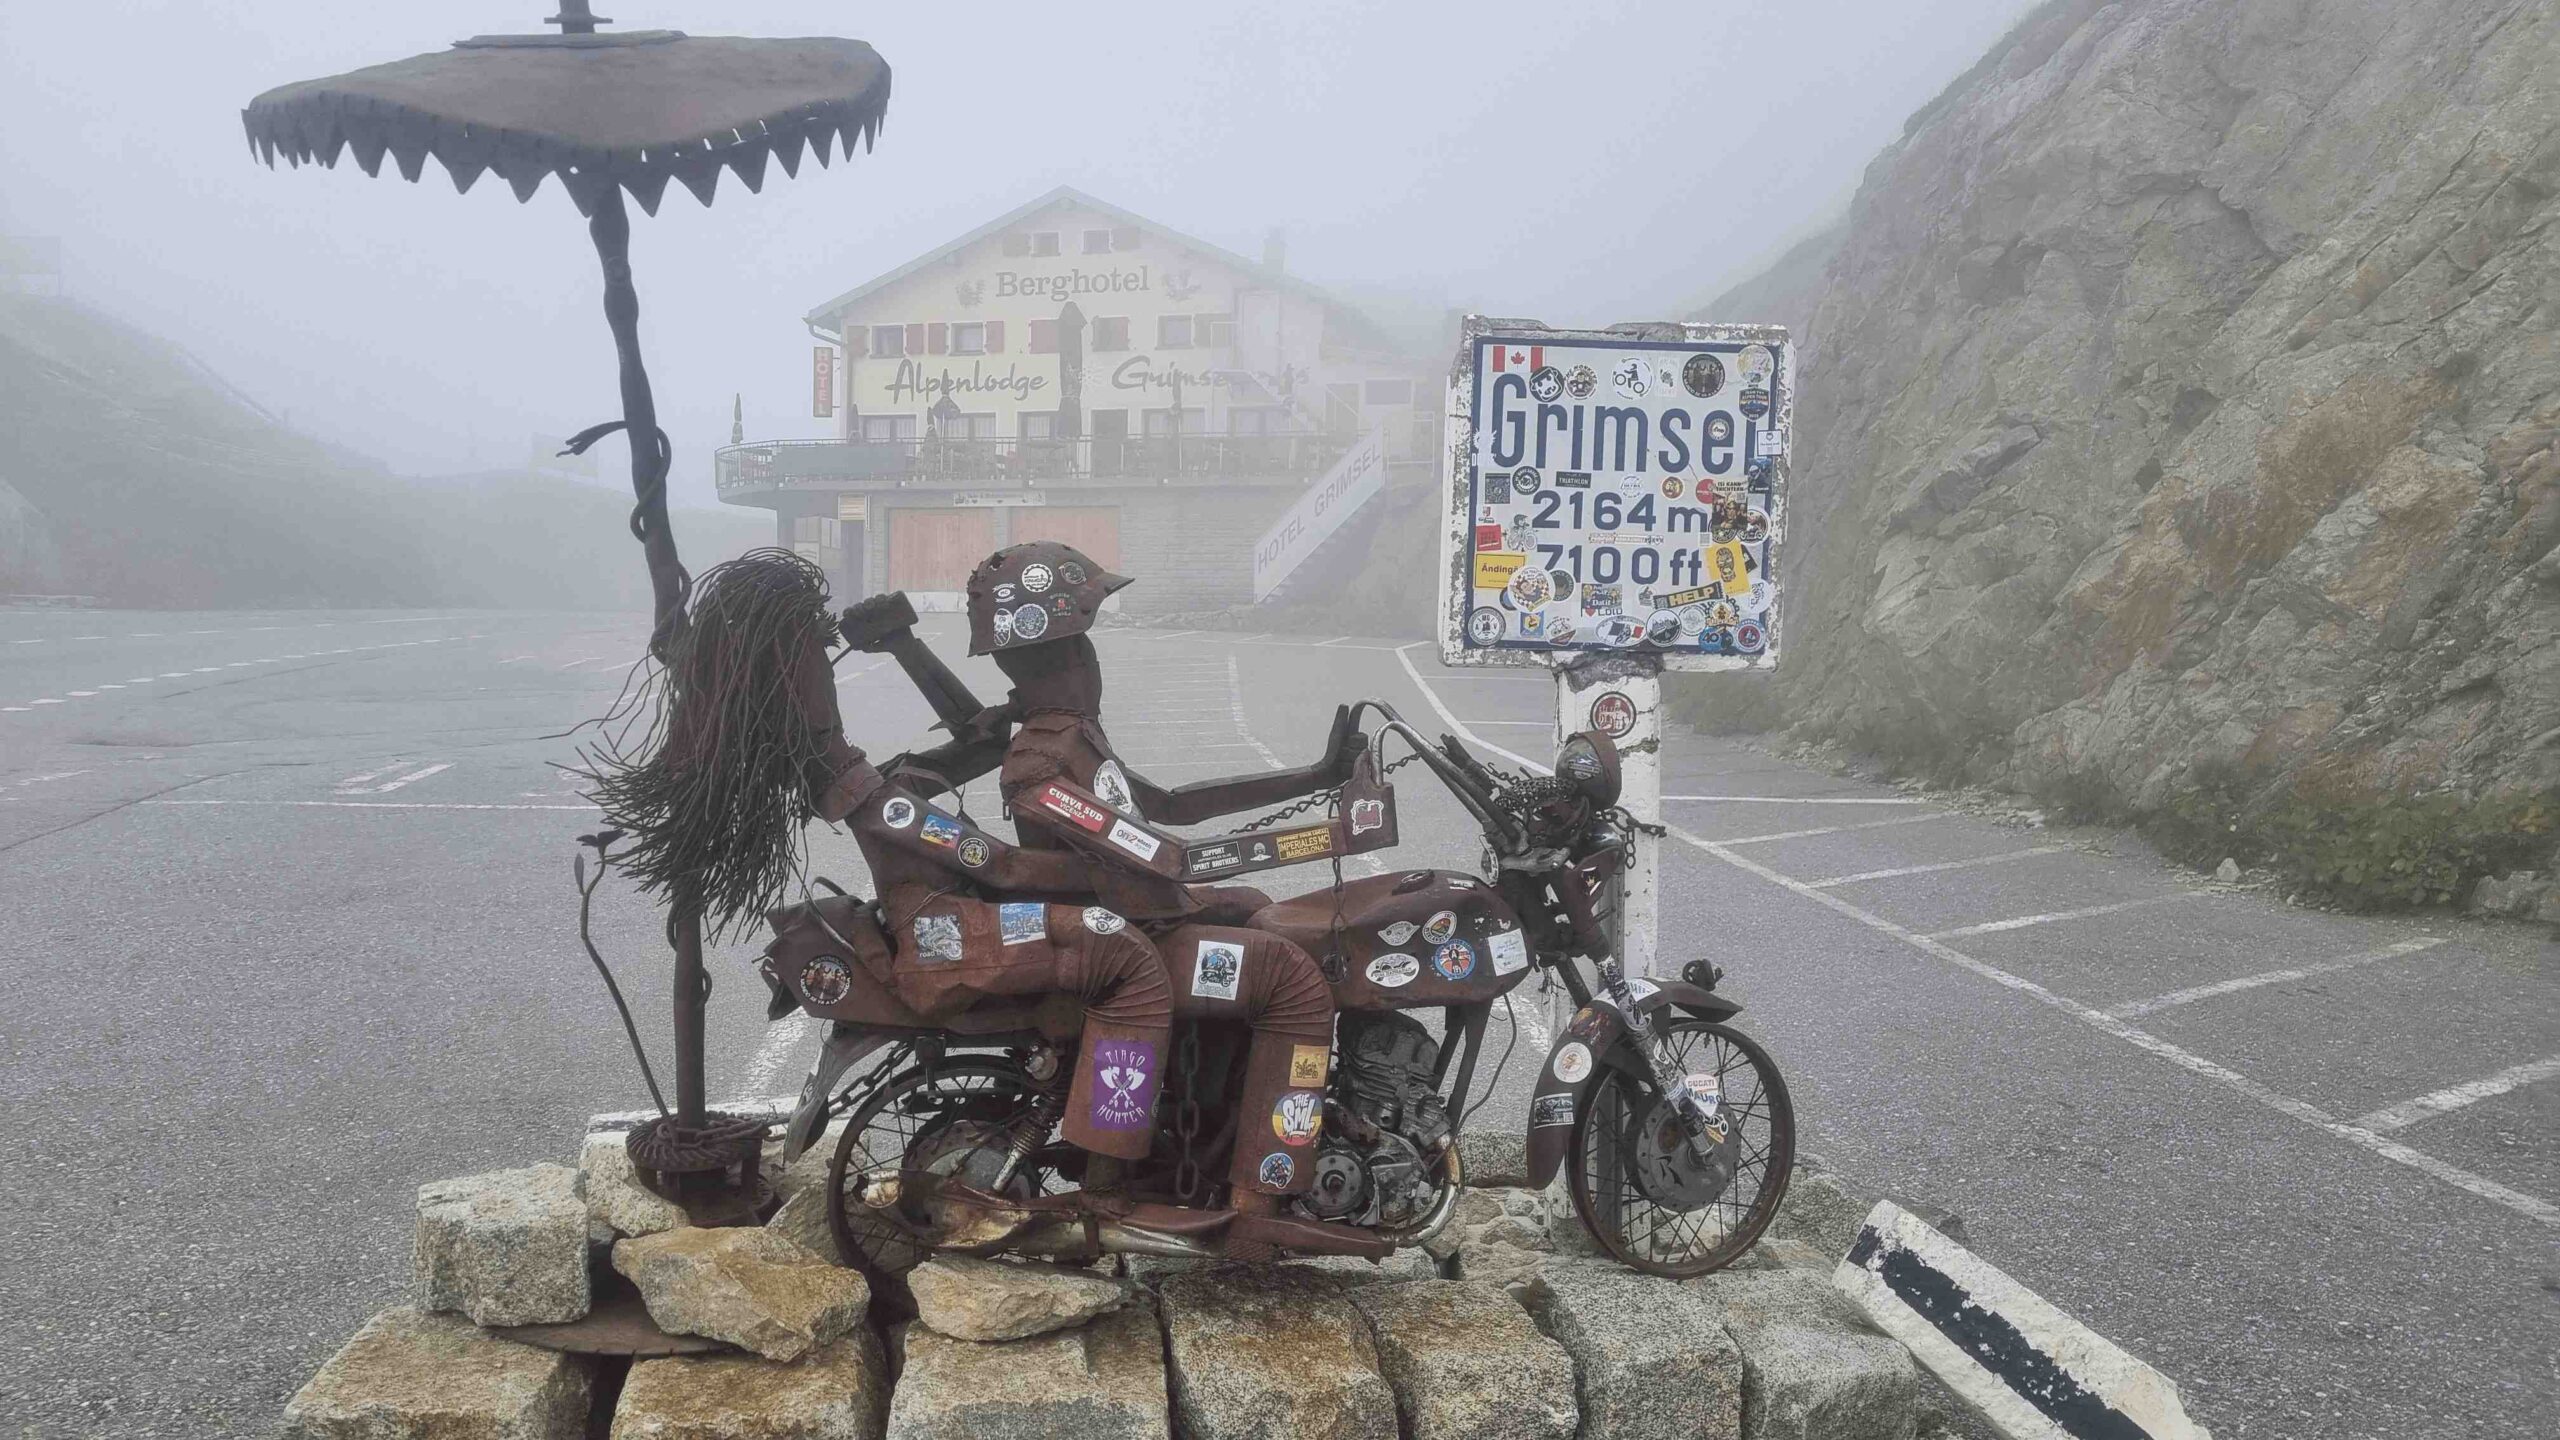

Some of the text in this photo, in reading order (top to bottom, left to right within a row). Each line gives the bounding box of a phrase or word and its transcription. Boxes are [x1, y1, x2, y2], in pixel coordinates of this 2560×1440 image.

[995, 265, 1150, 302] Berghotel
[1112, 345, 1233, 393] Grimse
[815, 349, 830, 415] HOTEL
[1491, 374, 1757, 476] Grimsel
[1559, 477, 1590, 486] TRIATHLON
[1258, 444, 1380, 574] HOTEL GRIMSEL
[1532, 490, 1707, 532] 2164 m
[1537, 544, 1660, 585] 7100
[1669, 548, 1702, 587] ft
[1668, 586, 1715, 607] HELP
[1049, 787, 1103, 821] CURVA SUD
[1060, 801, 1086, 819] VICENZA
[1317, 834, 1330, 845] MC
[1201, 847, 1225, 857] SUPPORT
[1286, 844, 1325, 858] BARCELONA
[1192, 856, 1239, 871] SPIRIT BROTHERS
[920, 950, 936, 958] road
[1105, 1050, 1145, 1067] TIAGO
[1688, 1079, 1715, 1087] DUCATI
[1293, 1093, 1310, 1107] THE
[1097, 1104, 1145, 1124] HUNTER
